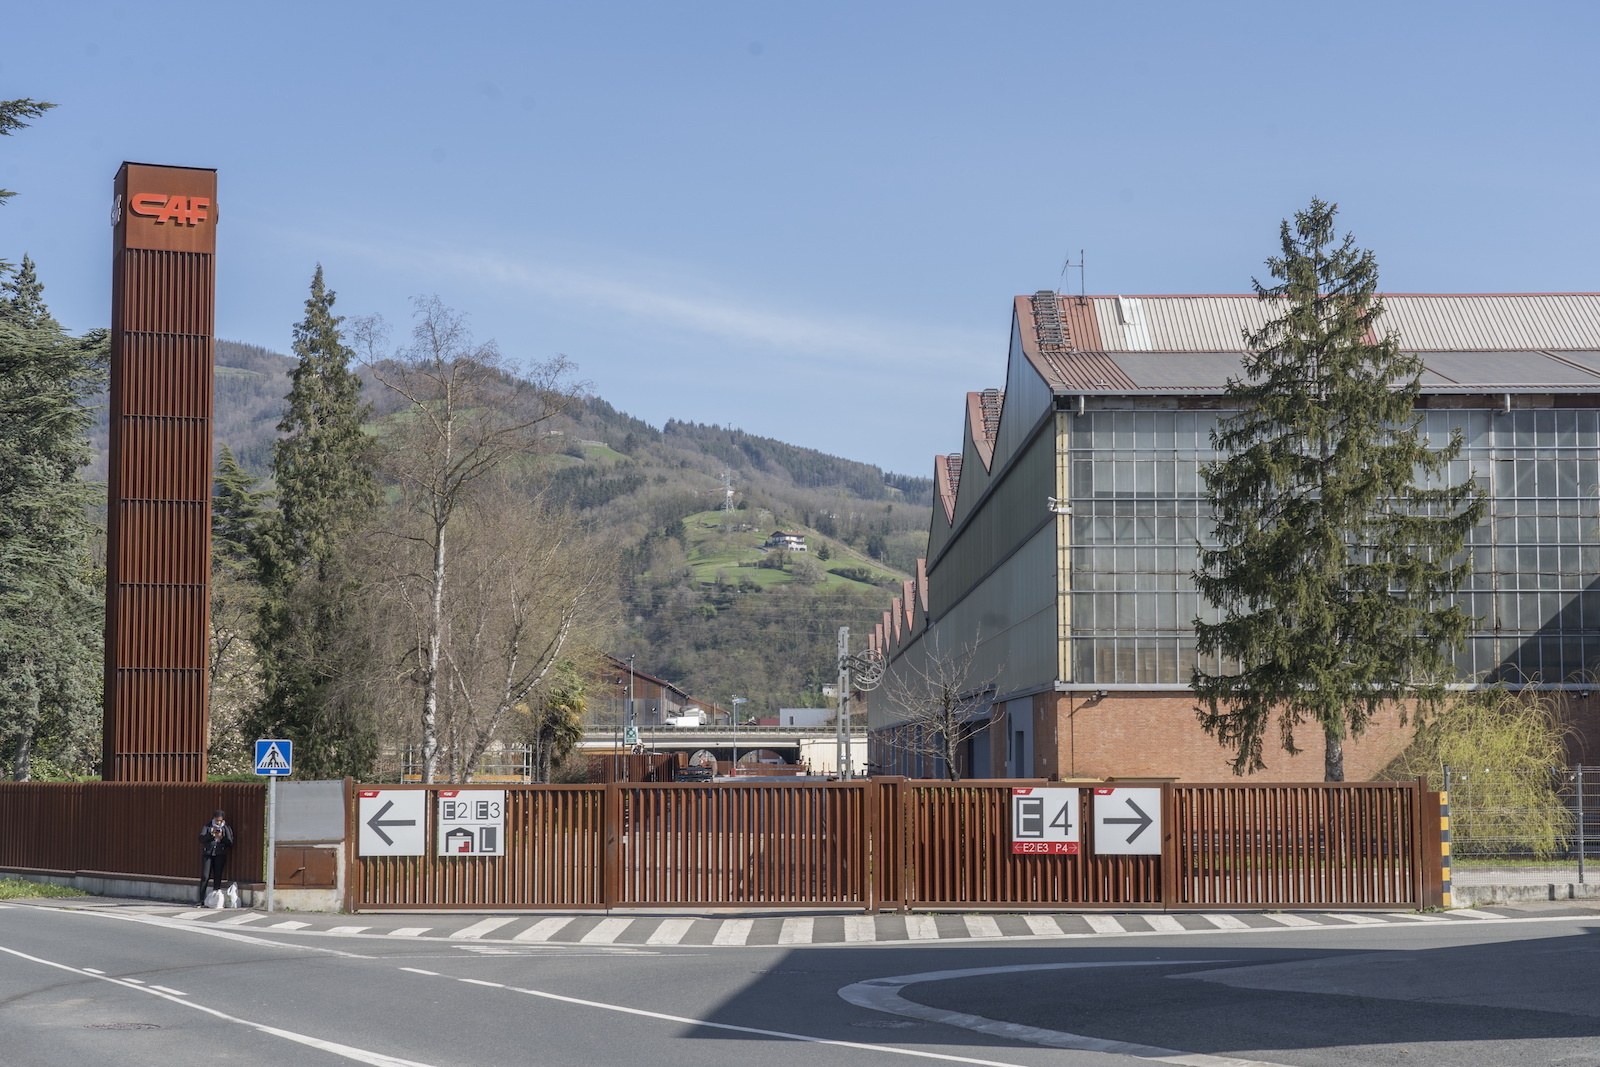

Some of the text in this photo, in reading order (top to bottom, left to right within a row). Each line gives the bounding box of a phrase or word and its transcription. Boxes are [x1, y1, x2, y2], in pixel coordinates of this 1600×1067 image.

[131, 193, 210, 225] CAF
[443, 801, 501, 820] E2 E3
[1017, 798, 1072, 838] E4
[481, 828, 495, 851] L
[1023, 843, 1068, 853] E2 E3 P4
